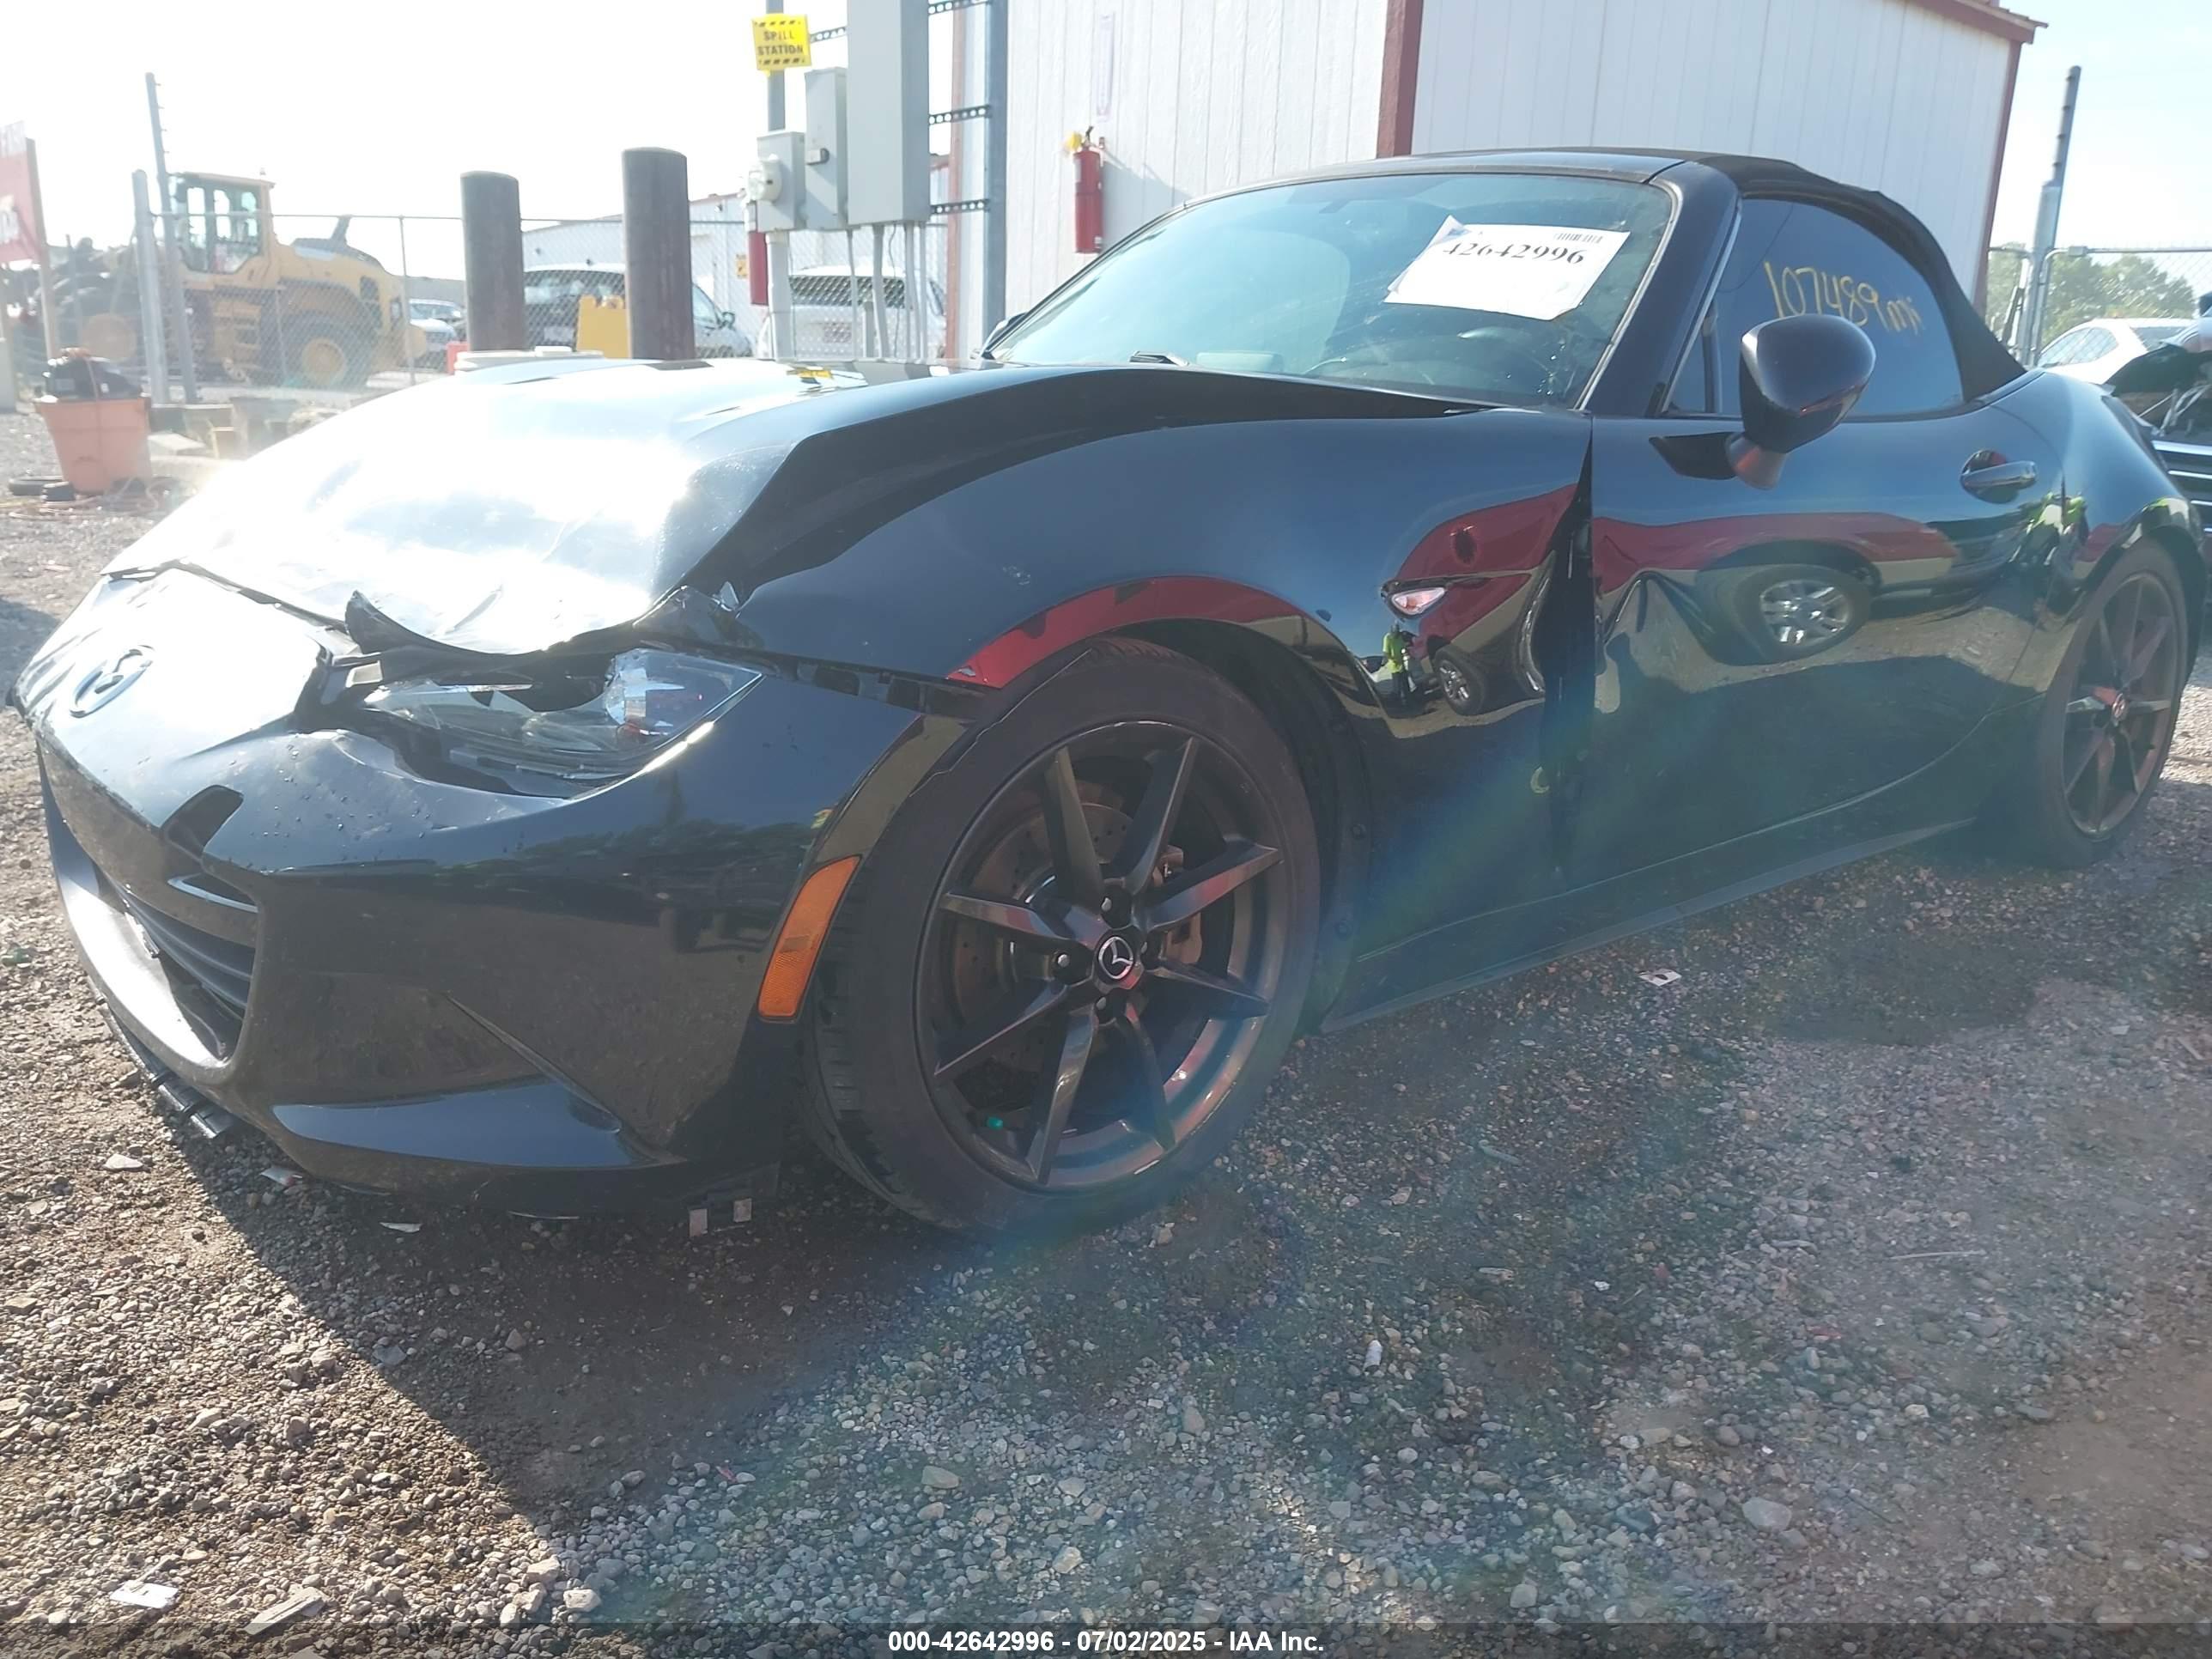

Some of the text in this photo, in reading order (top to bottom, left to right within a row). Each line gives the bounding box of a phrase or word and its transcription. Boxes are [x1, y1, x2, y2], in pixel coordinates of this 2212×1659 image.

[763, 30, 795, 41] SPILL
[757, 44, 804, 56] STATION
[1443, 242, 1586, 264] 42642996
